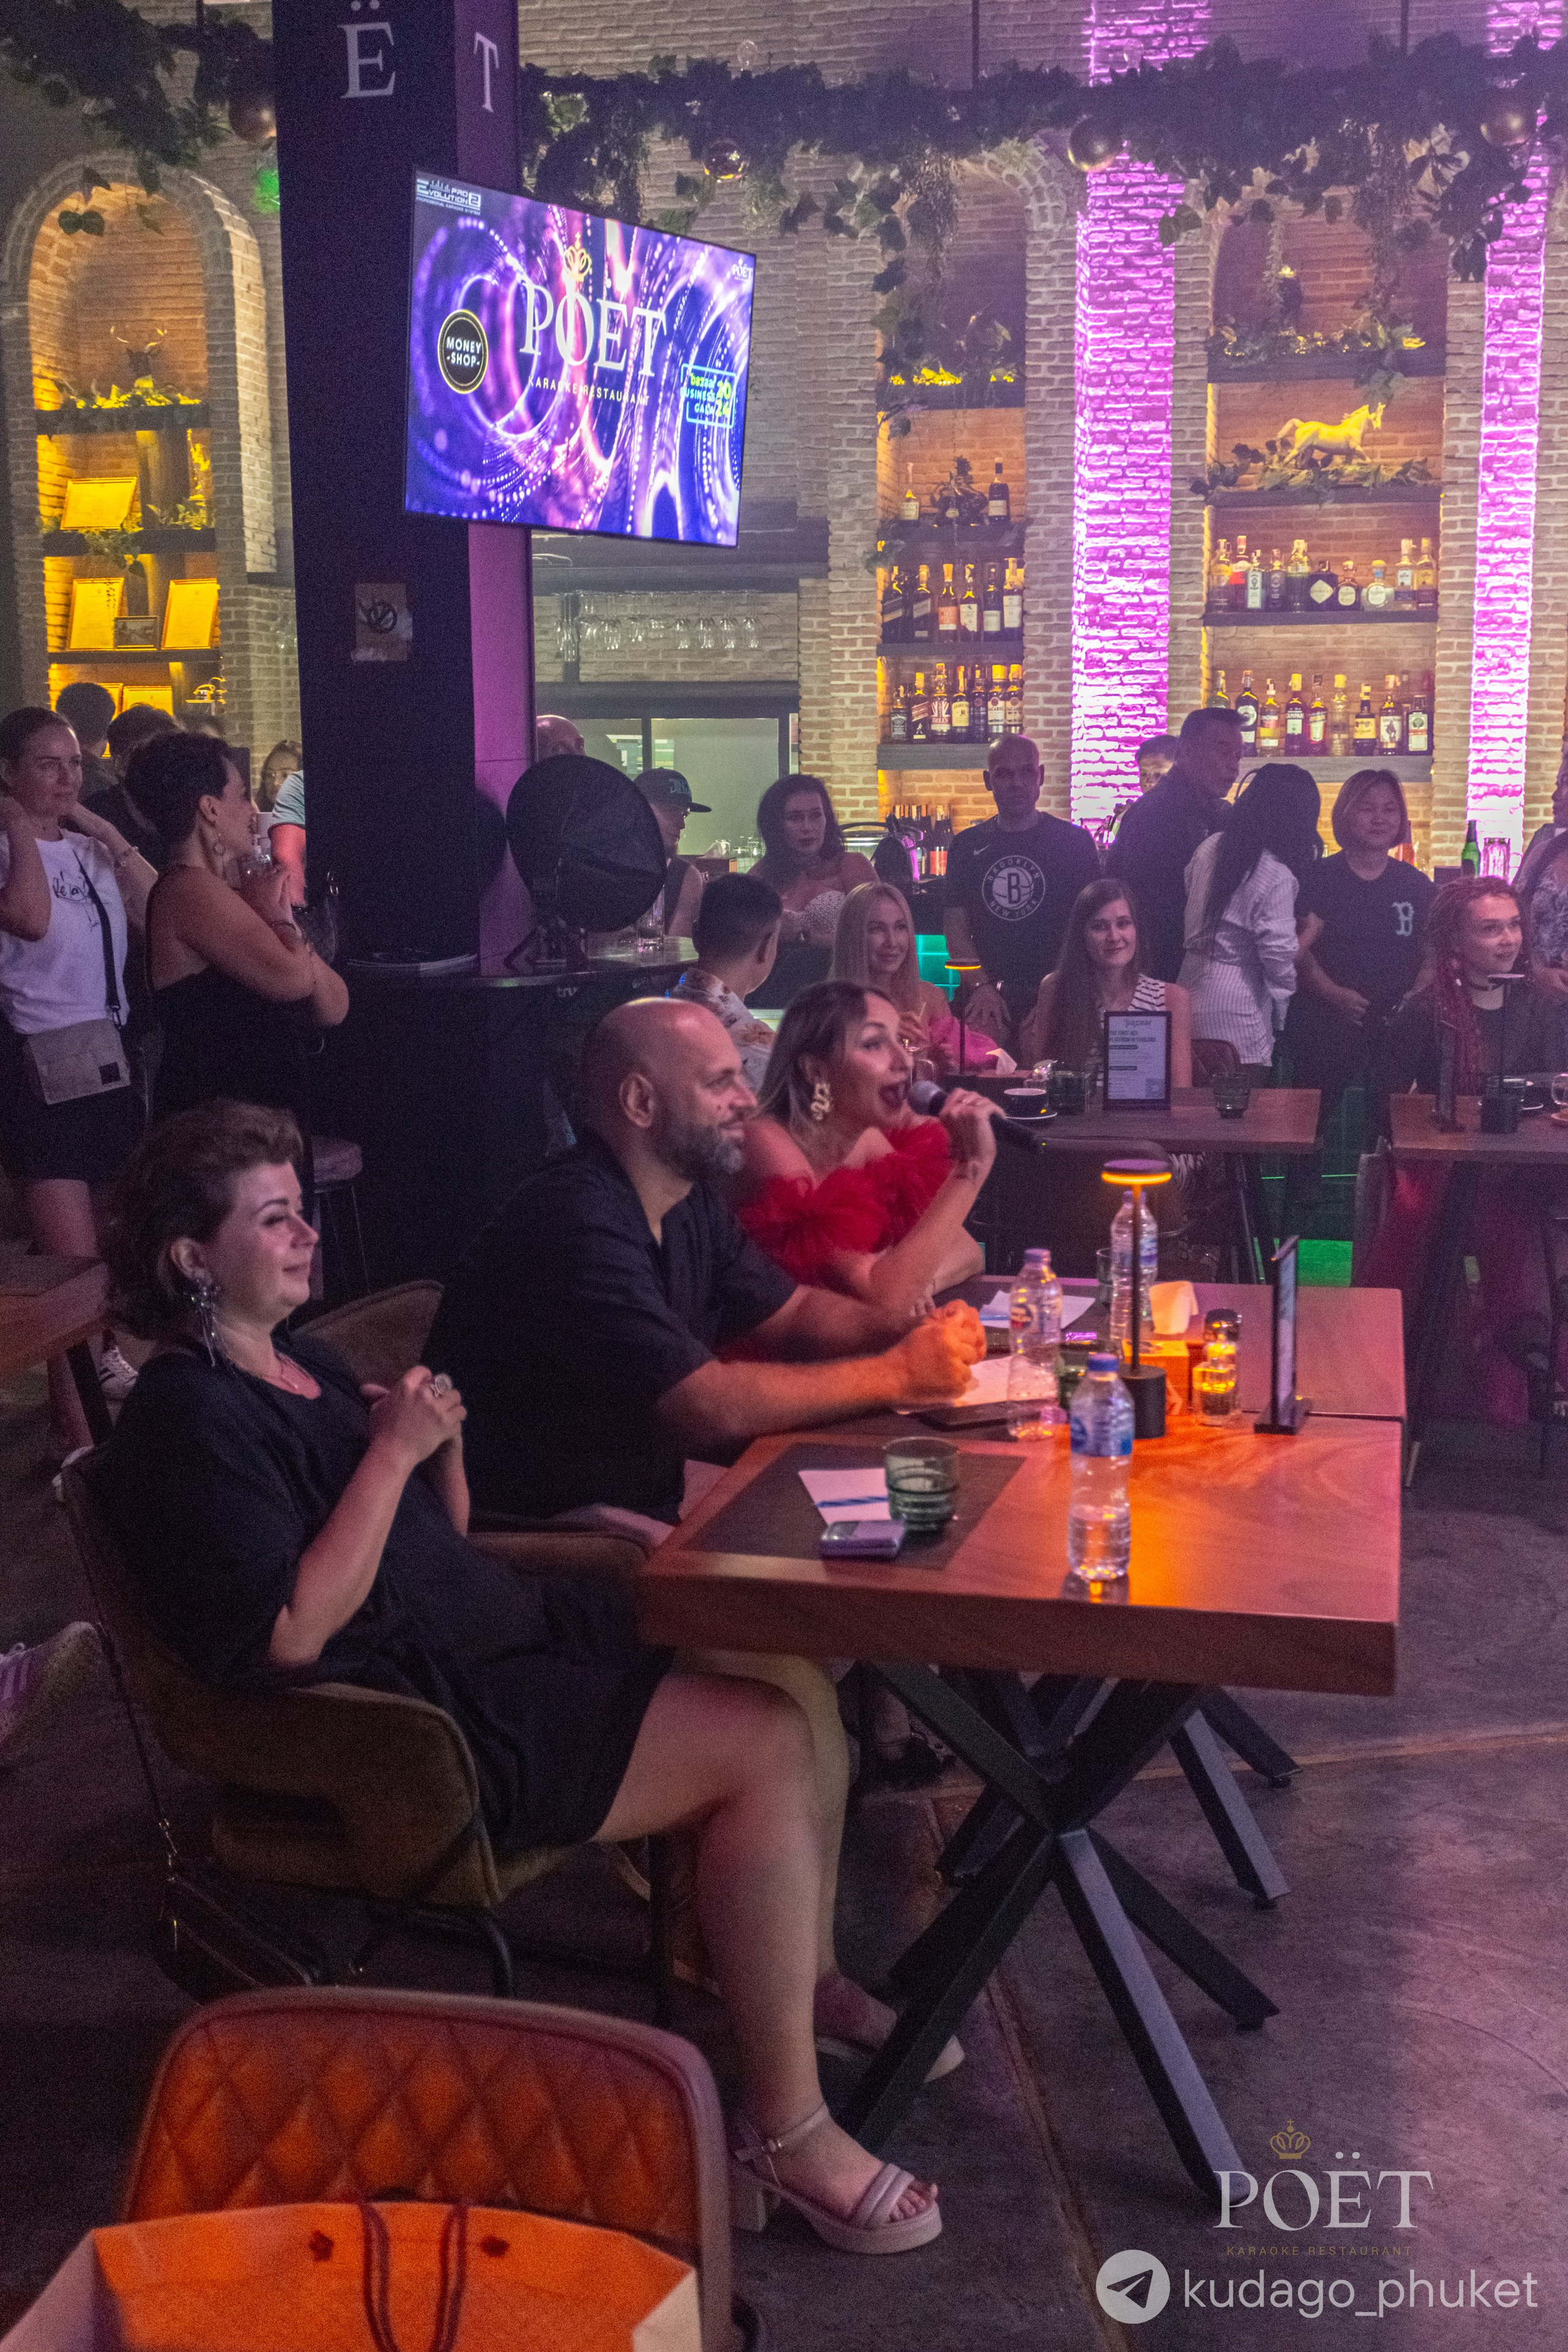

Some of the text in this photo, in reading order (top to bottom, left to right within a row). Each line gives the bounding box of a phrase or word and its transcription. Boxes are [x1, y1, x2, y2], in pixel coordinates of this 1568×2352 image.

[473, 31, 499, 113] T
[447, 336, 481, 354] MONEY
[528, 376, 649, 407] KARAOKE RESTAURANT
[987, 858, 1041, 881] BROOKLYN
[1008, 872, 1022, 905] B
[989, 900, 1011, 917] NEW
[1392, 901, 1415, 937] B
